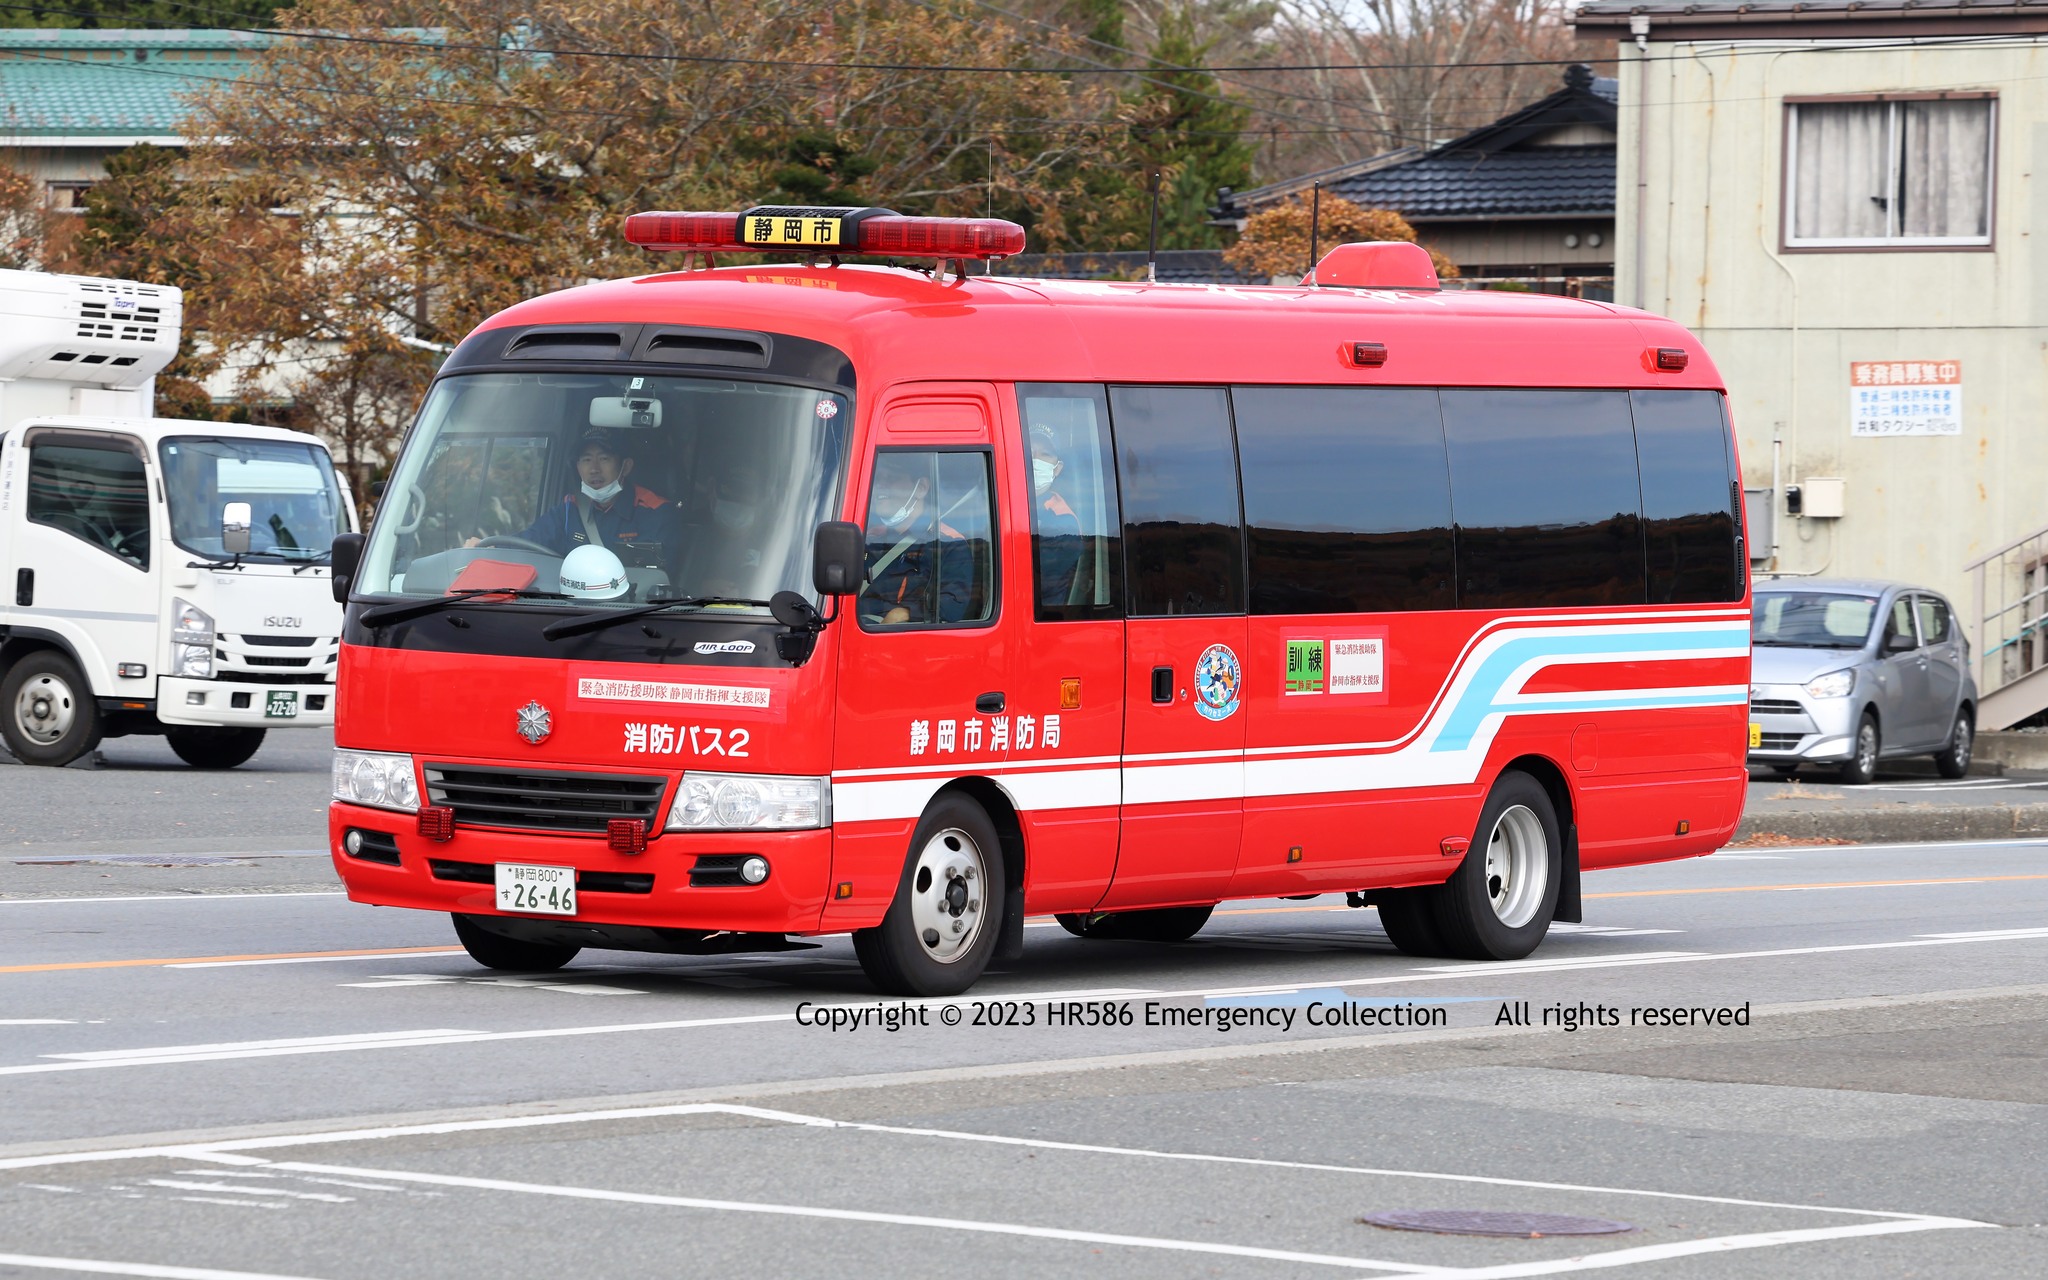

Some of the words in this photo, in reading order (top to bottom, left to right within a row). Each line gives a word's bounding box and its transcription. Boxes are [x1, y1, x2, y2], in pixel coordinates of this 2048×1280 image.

[754, 218, 833, 243] 静岡市
[264, 617, 302, 628] ISUZU
[720, 644, 753, 652] LOOP
[1289, 646, 1322, 673] 訓練
[1335, 644, 1376, 656] 緊急消防援助隊
[581, 681, 667, 699] 緊急消防援助隊
[669, 688, 767, 705] 静岡市指揮支援隊
[1332, 675, 1379, 687] 静岡市指揮支援隊
[623, 722, 751, 758] 消防バス2
[910, 714, 1061, 756] 静岡市消防局
[514, 883, 572, 911] 26-46
